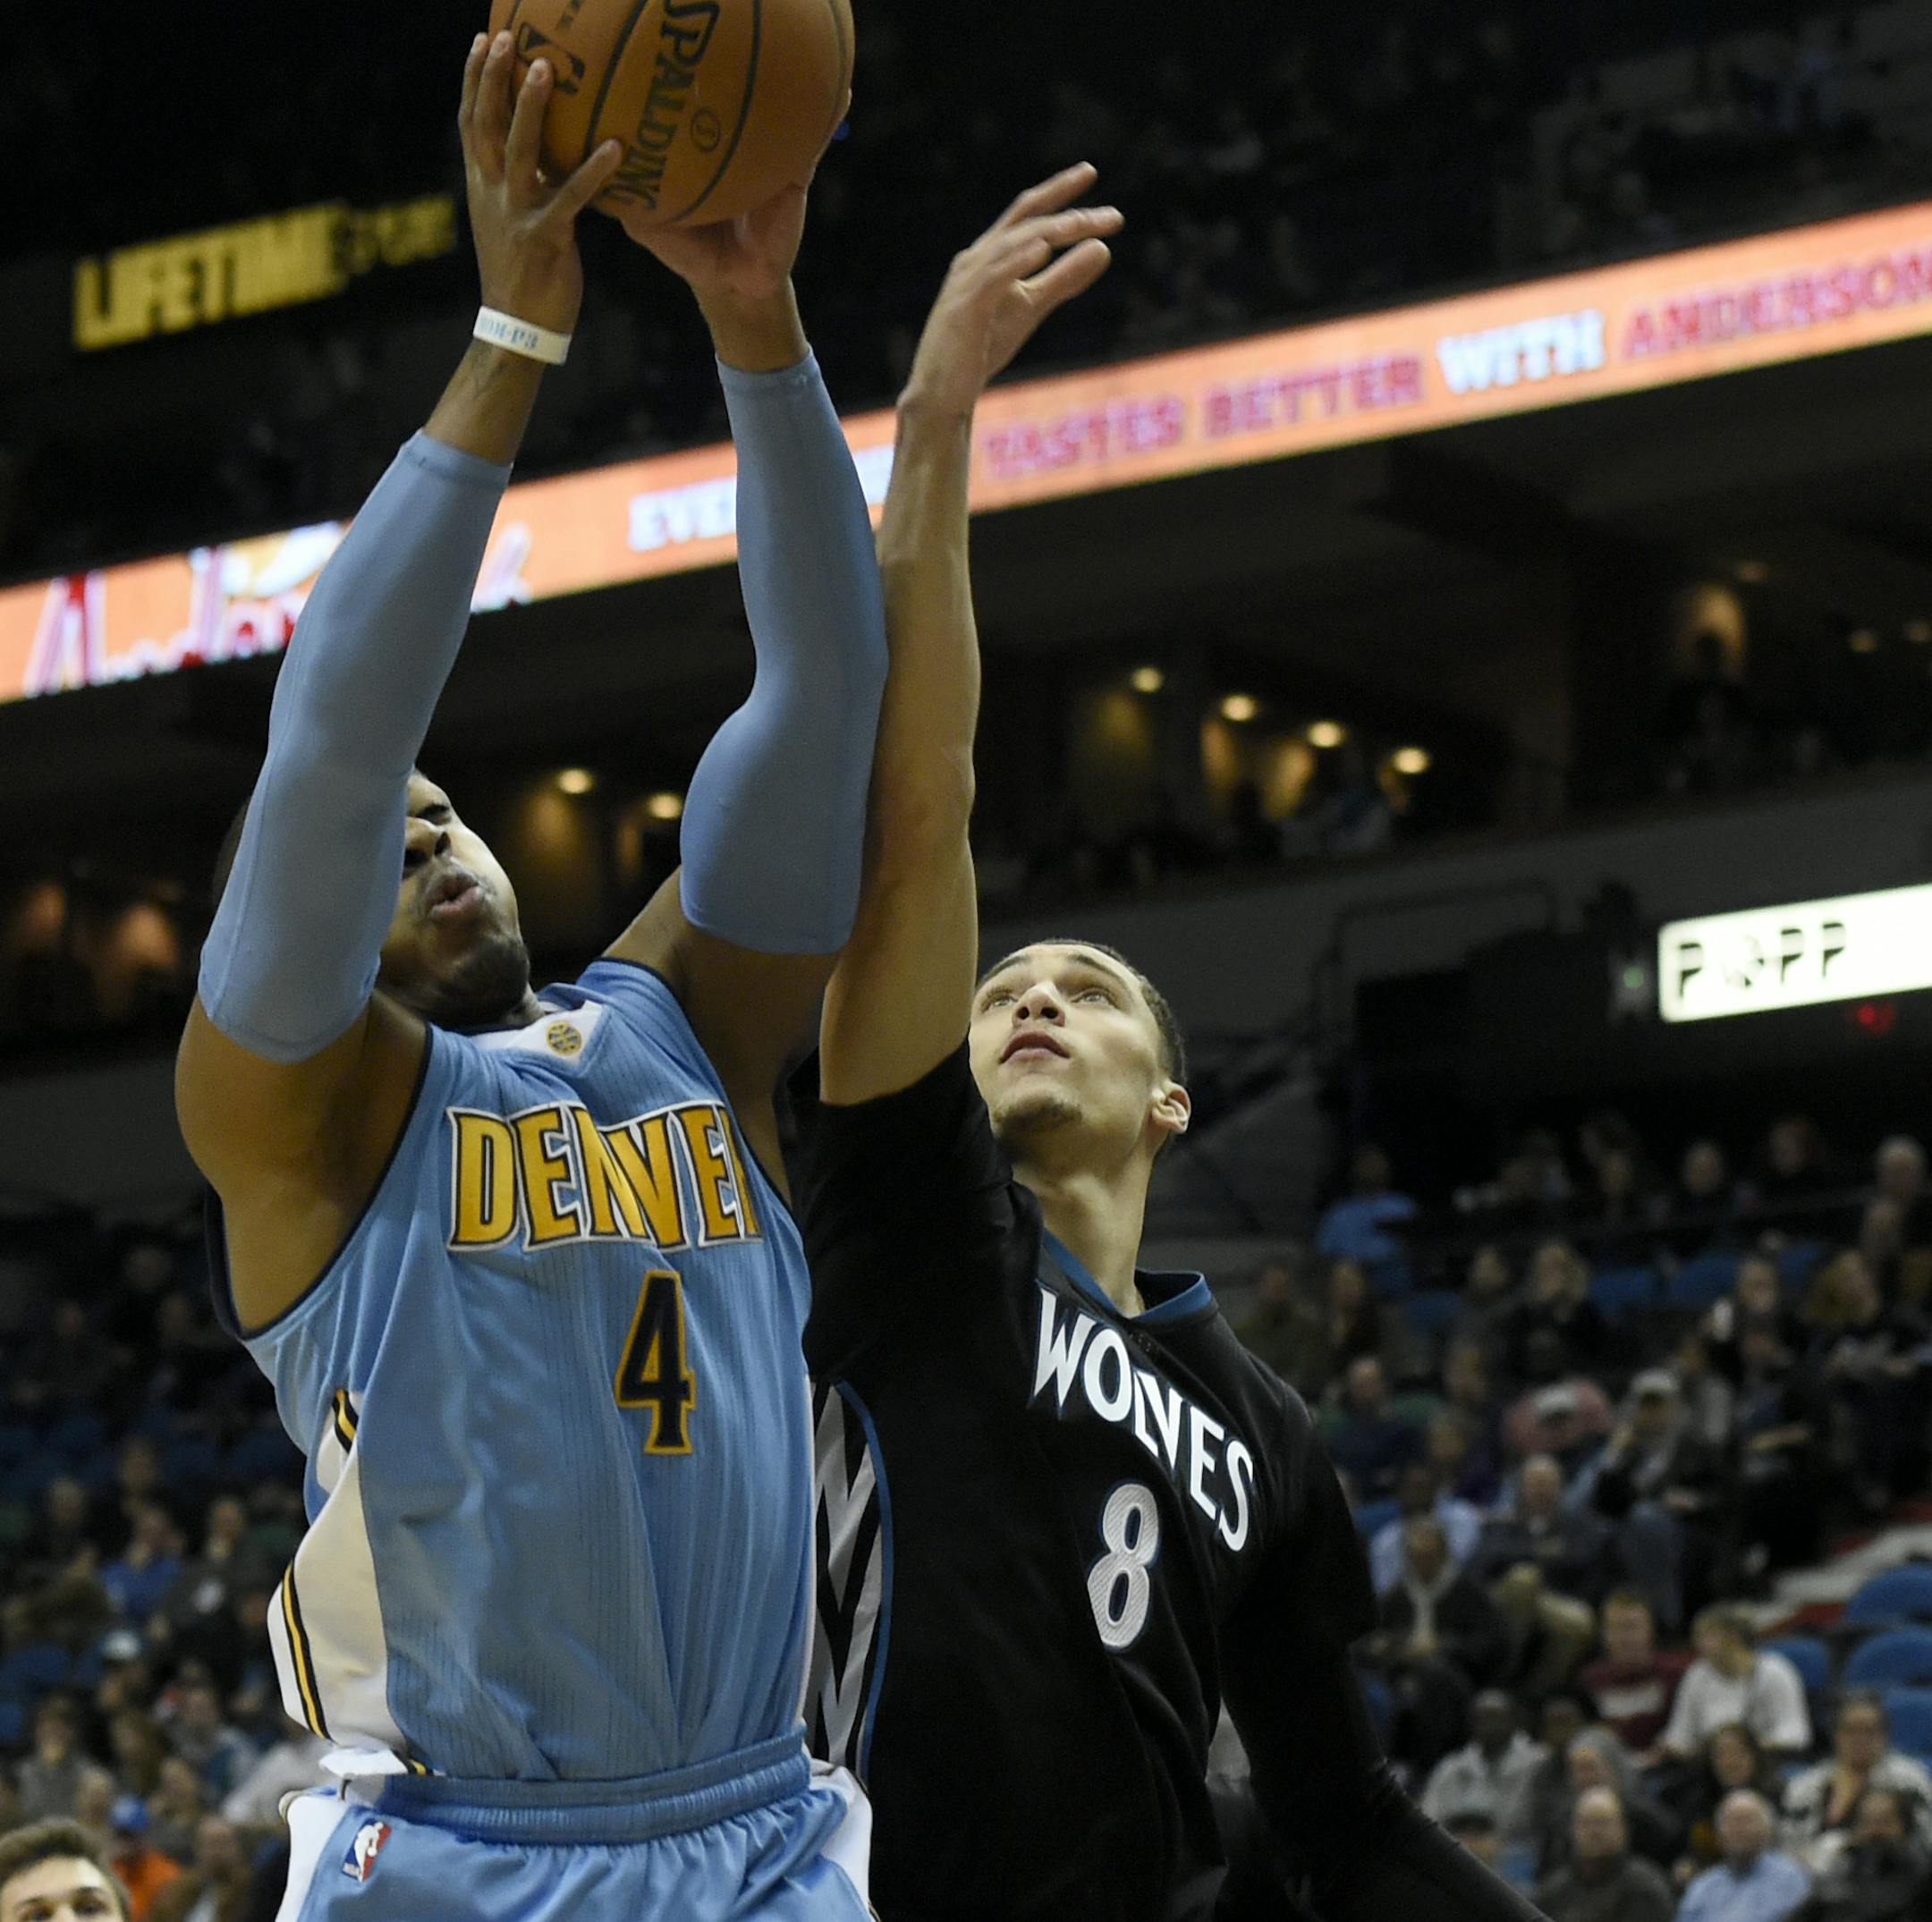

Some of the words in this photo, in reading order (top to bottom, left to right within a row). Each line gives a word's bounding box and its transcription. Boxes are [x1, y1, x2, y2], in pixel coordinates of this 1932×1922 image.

[987, 396, 1185, 480] TASTES
[1204, 354, 1422, 441] BETTER
[1436, 309, 1606, 394] WITH
[614, 1269, 696, 1456] 4
[1032, 1286, 1253, 1552] WOLVES
[1087, 1482, 1160, 1648] 8
